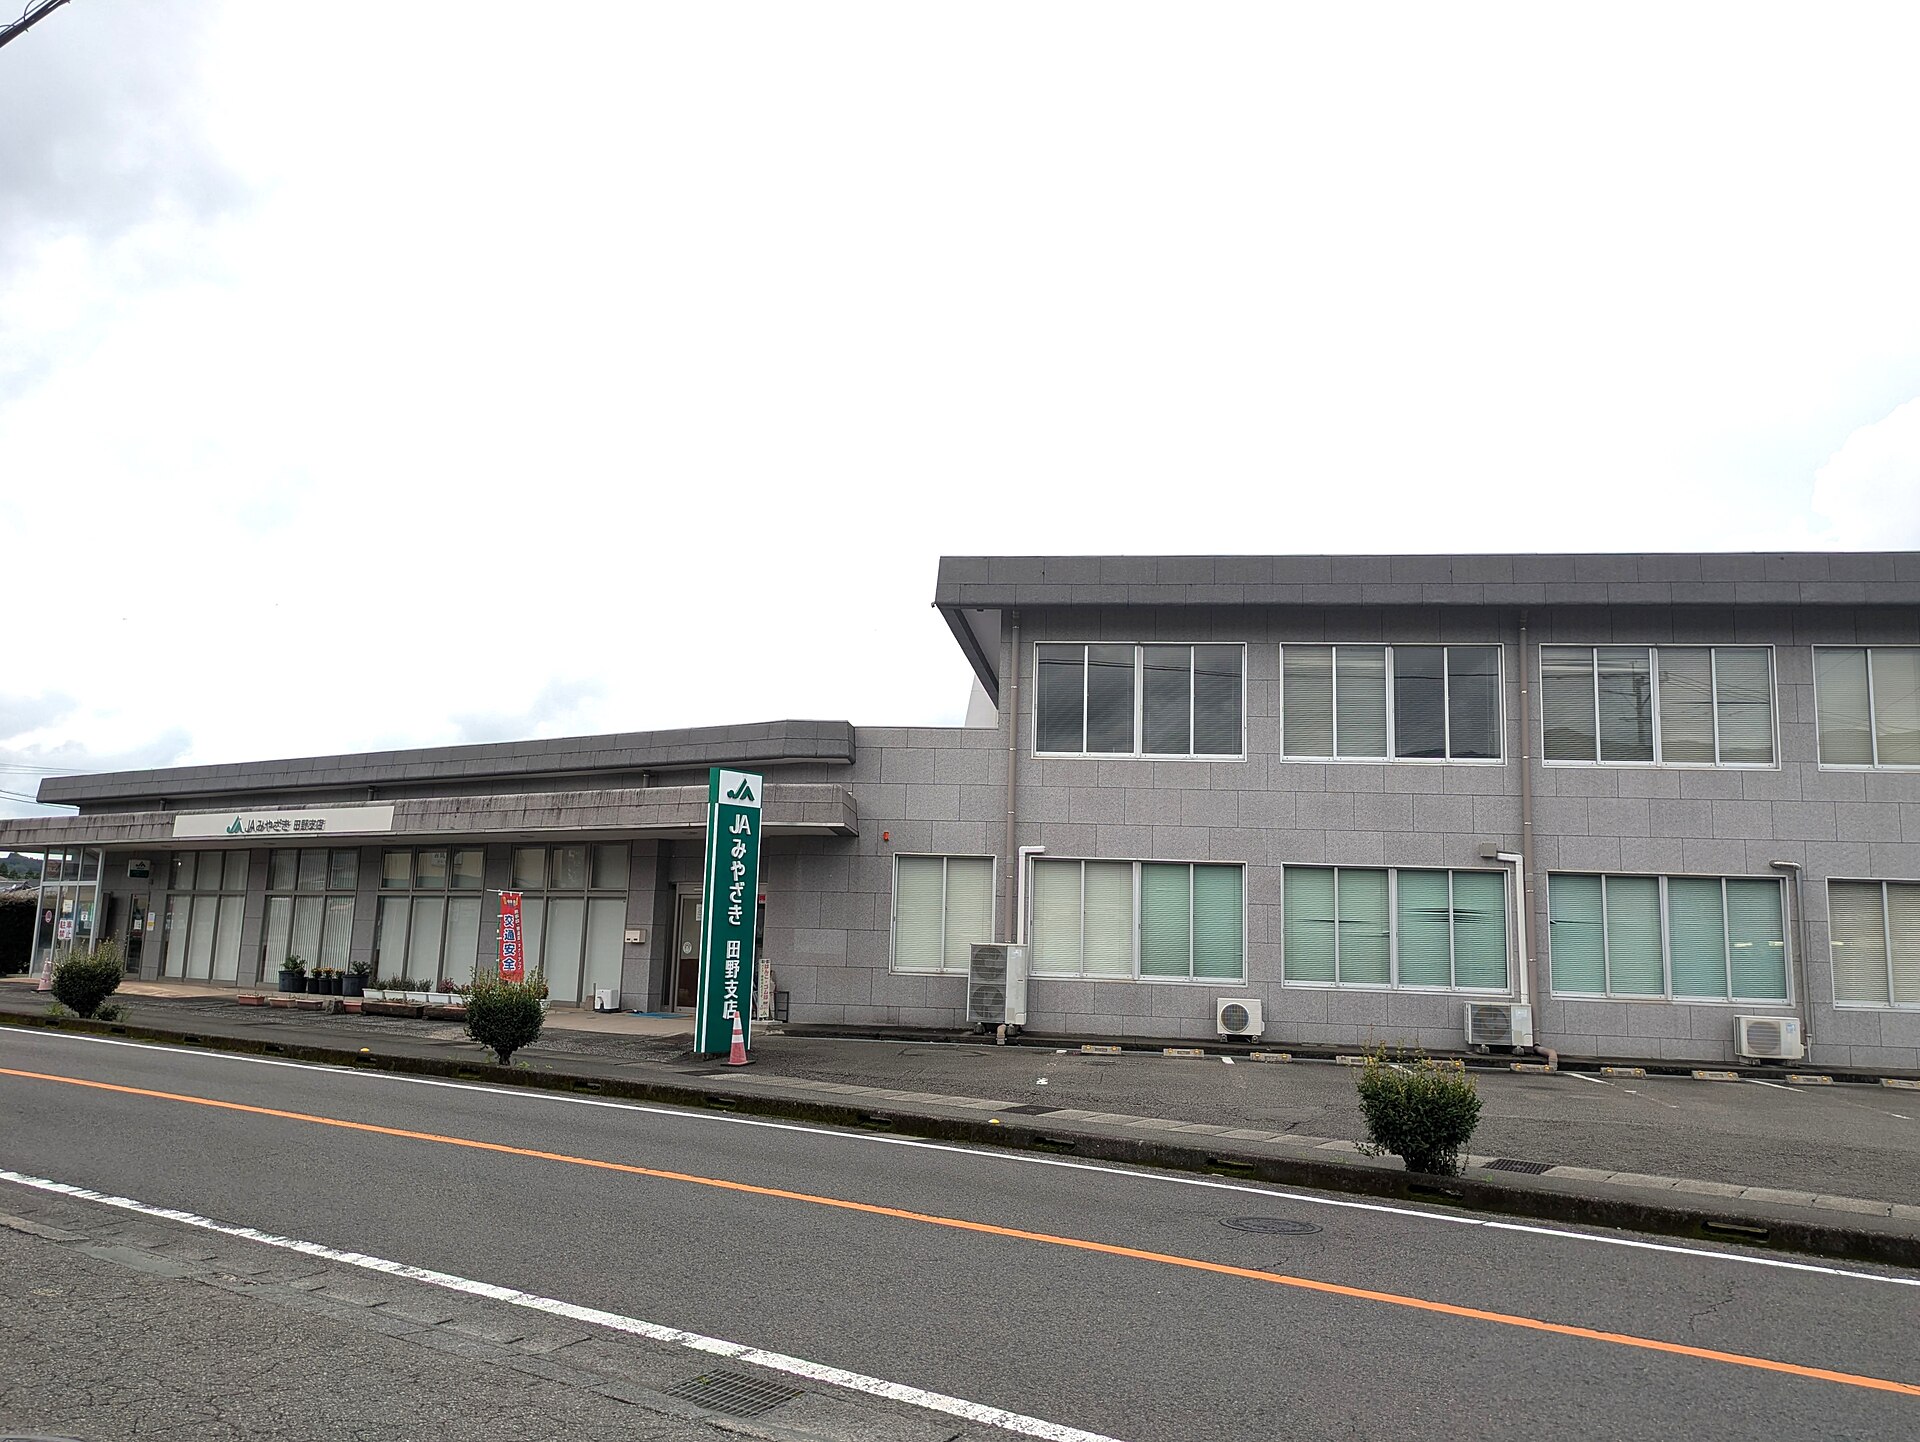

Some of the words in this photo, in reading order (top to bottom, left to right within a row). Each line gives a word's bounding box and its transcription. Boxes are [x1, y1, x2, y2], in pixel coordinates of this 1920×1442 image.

[728, 814, 751, 926] JAみやざき
[502, 913, 516, 971] 交通安全
[722, 940, 740, 1019] 田野支店
